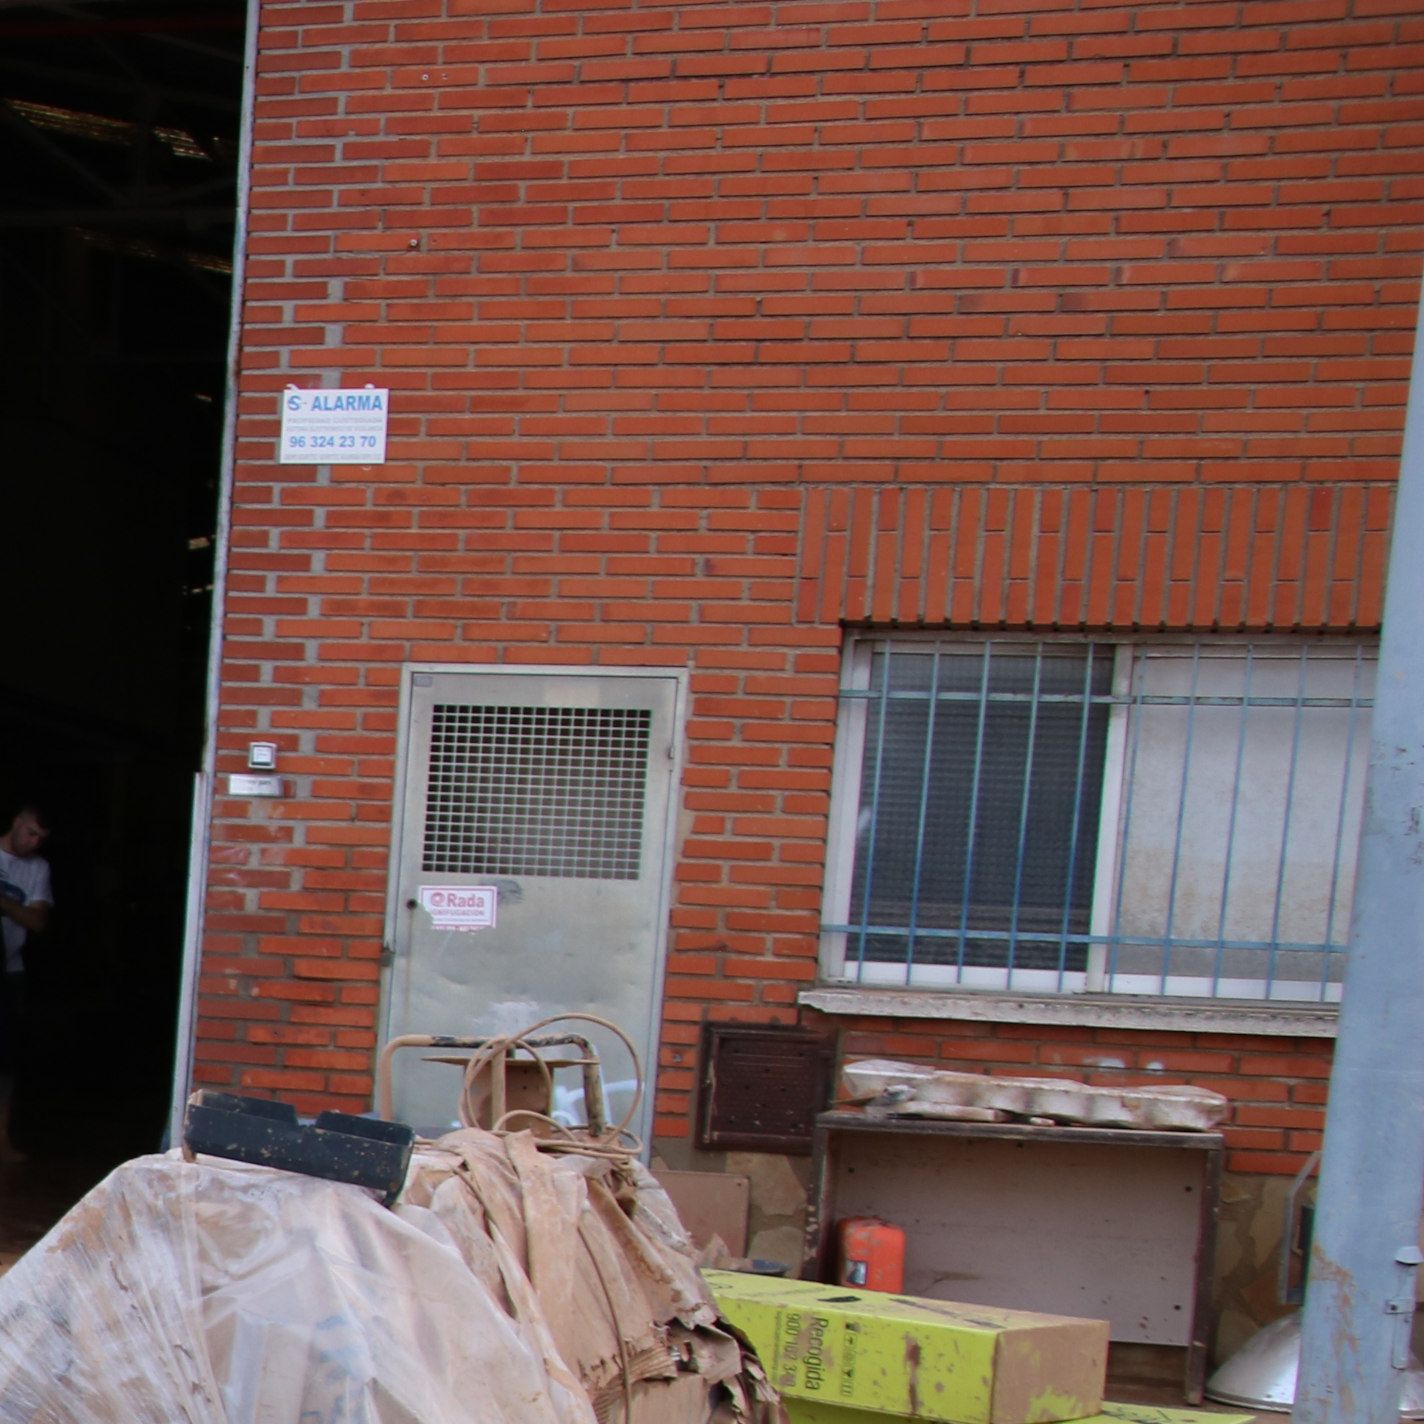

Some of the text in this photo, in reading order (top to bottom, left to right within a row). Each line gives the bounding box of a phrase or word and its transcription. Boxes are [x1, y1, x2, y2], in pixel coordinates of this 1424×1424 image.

[311, 395, 383, 412] ALARMA
[289, 436, 377, 448] 96 324 23 70
[447, 893, 485, 908] Rada
[785, 1313, 801, 1336] 900
[803, 1317, 829, 1390] Recogida
